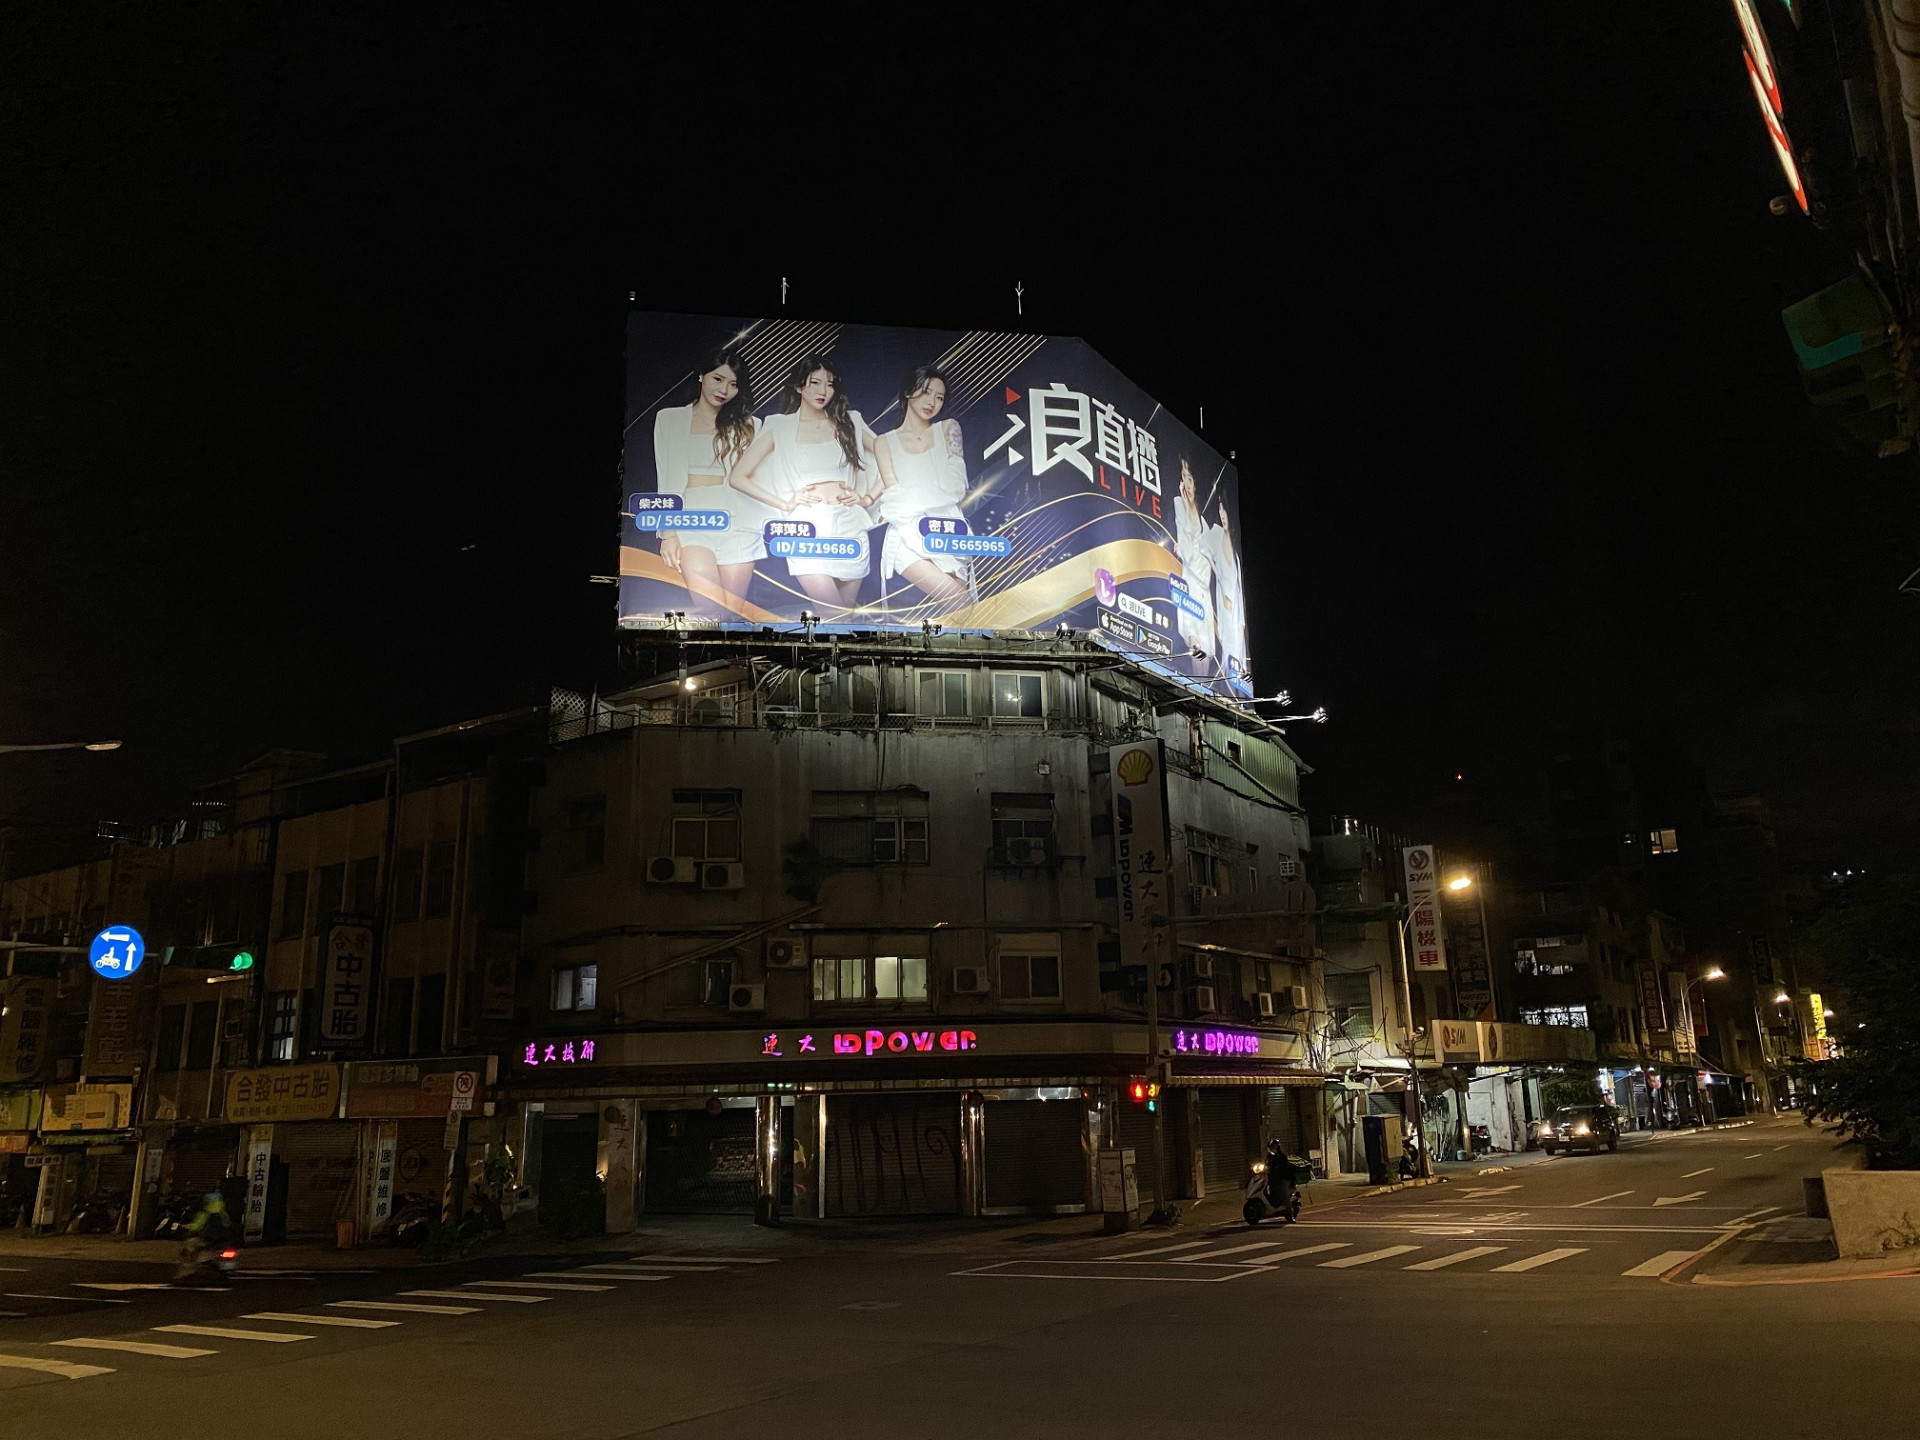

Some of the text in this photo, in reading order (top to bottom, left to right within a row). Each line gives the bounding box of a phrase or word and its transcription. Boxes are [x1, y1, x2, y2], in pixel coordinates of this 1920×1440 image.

[983, 383, 1162, 496] 浪直播
[638, 498, 675, 510] 柴犬妹
[1099, 465, 1162, 519] LIVE
[641, 514, 725, 529] ID/ 5653142
[776, 541, 855, 556] ID/ 5719686
[930, 538, 1005, 552] ID/ 5665965
[1109, 621, 1121, 634] App
[1120, 625, 1134, 640] Store
[1147, 639, 1162, 653] Google
[1409, 872, 1433, 882] SYM
[1412, 889, 1439, 967] 三陽機車
[330, 953, 363, 1035] 中古胎
[237, 1069, 330, 1101] 合發中古胎
[251, 1152, 266, 1214] 中古輪胎
[375, 1150, 392, 1217] 底盤維修
